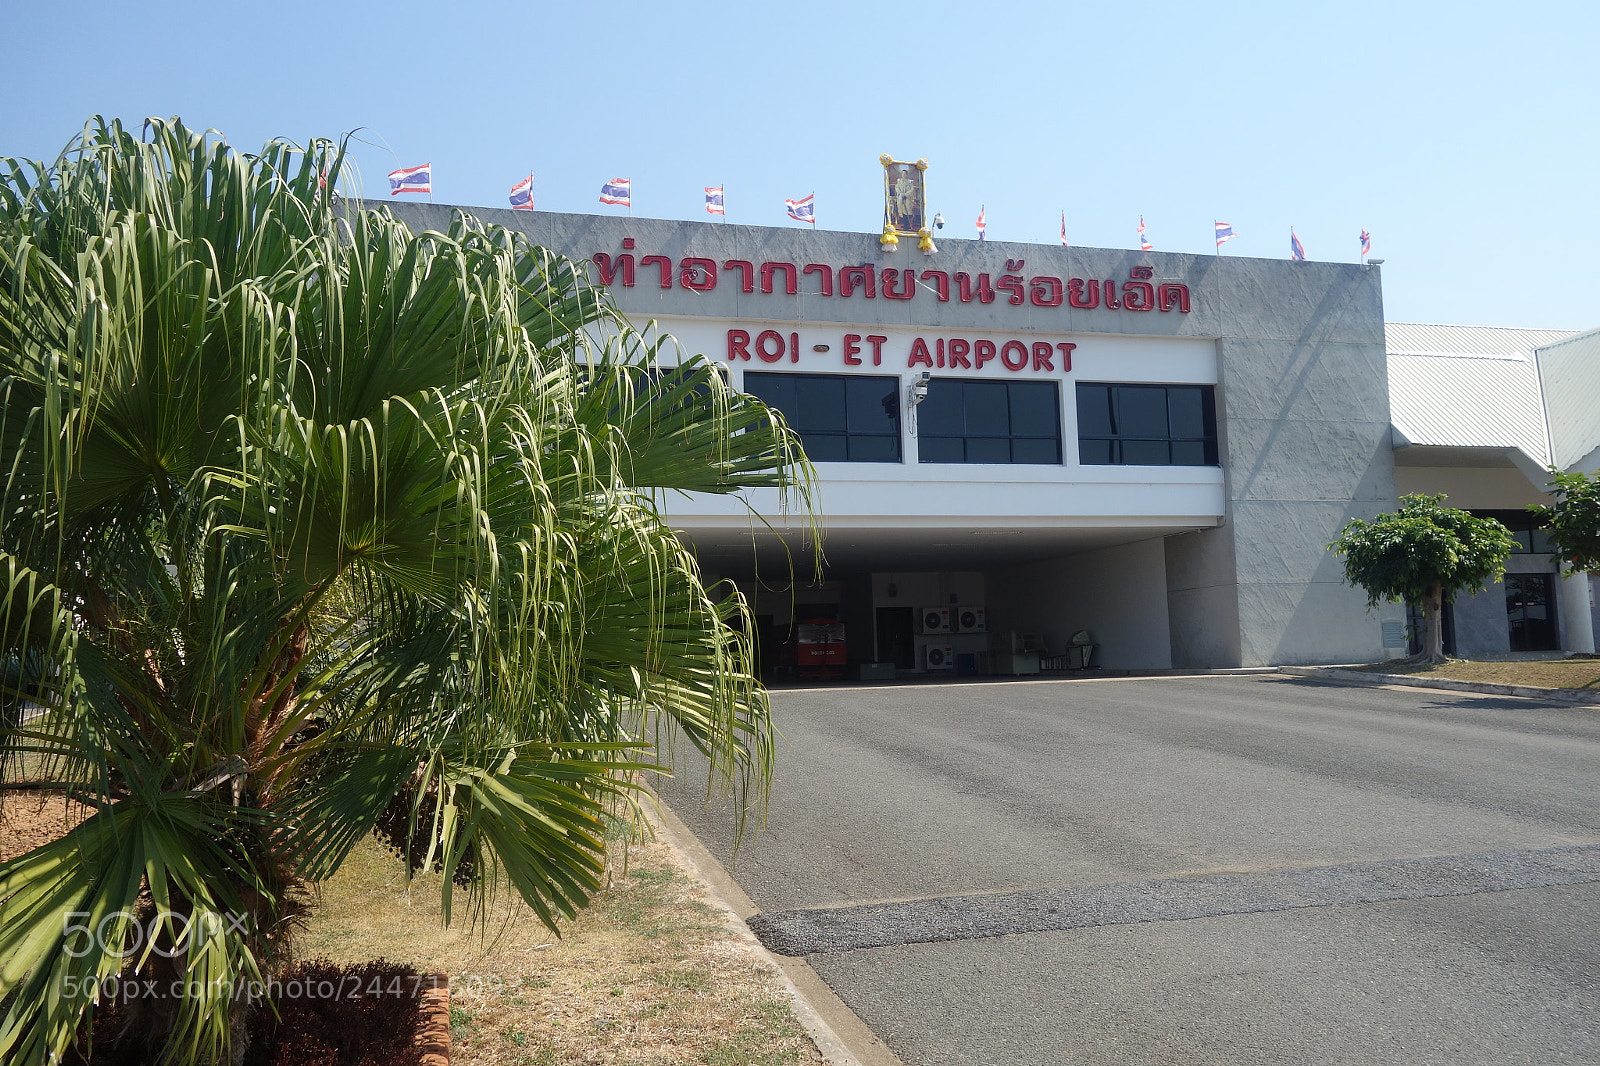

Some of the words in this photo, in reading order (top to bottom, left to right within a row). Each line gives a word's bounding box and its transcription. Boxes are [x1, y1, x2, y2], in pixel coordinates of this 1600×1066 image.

[592, 237, 1191, 313] ท่าอากาศยานร้อยเอ็ด
[727, 329, 799, 363] ROI
[843, 334, 887, 366] ET
[908, 337, 1077, 372] AIRPORT
